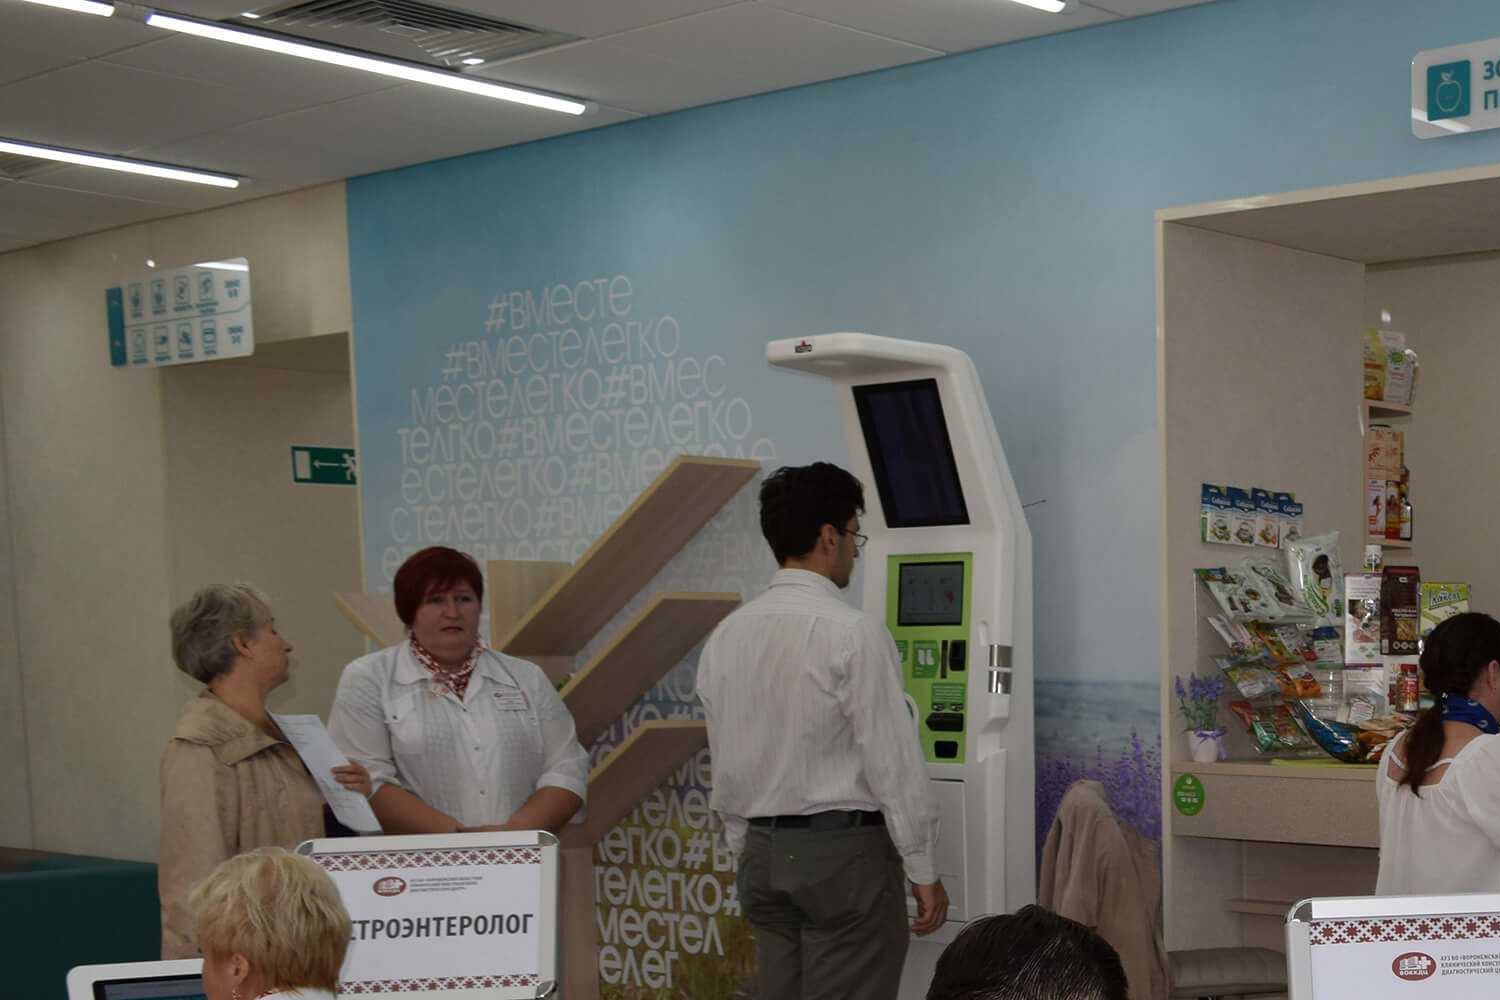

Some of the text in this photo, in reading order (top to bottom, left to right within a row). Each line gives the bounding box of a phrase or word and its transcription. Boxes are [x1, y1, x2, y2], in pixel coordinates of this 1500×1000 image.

[484, 274, 633, 334] #вместе
[442, 315, 681, 381] #вместелегко
[599, 945, 680, 989] елег
